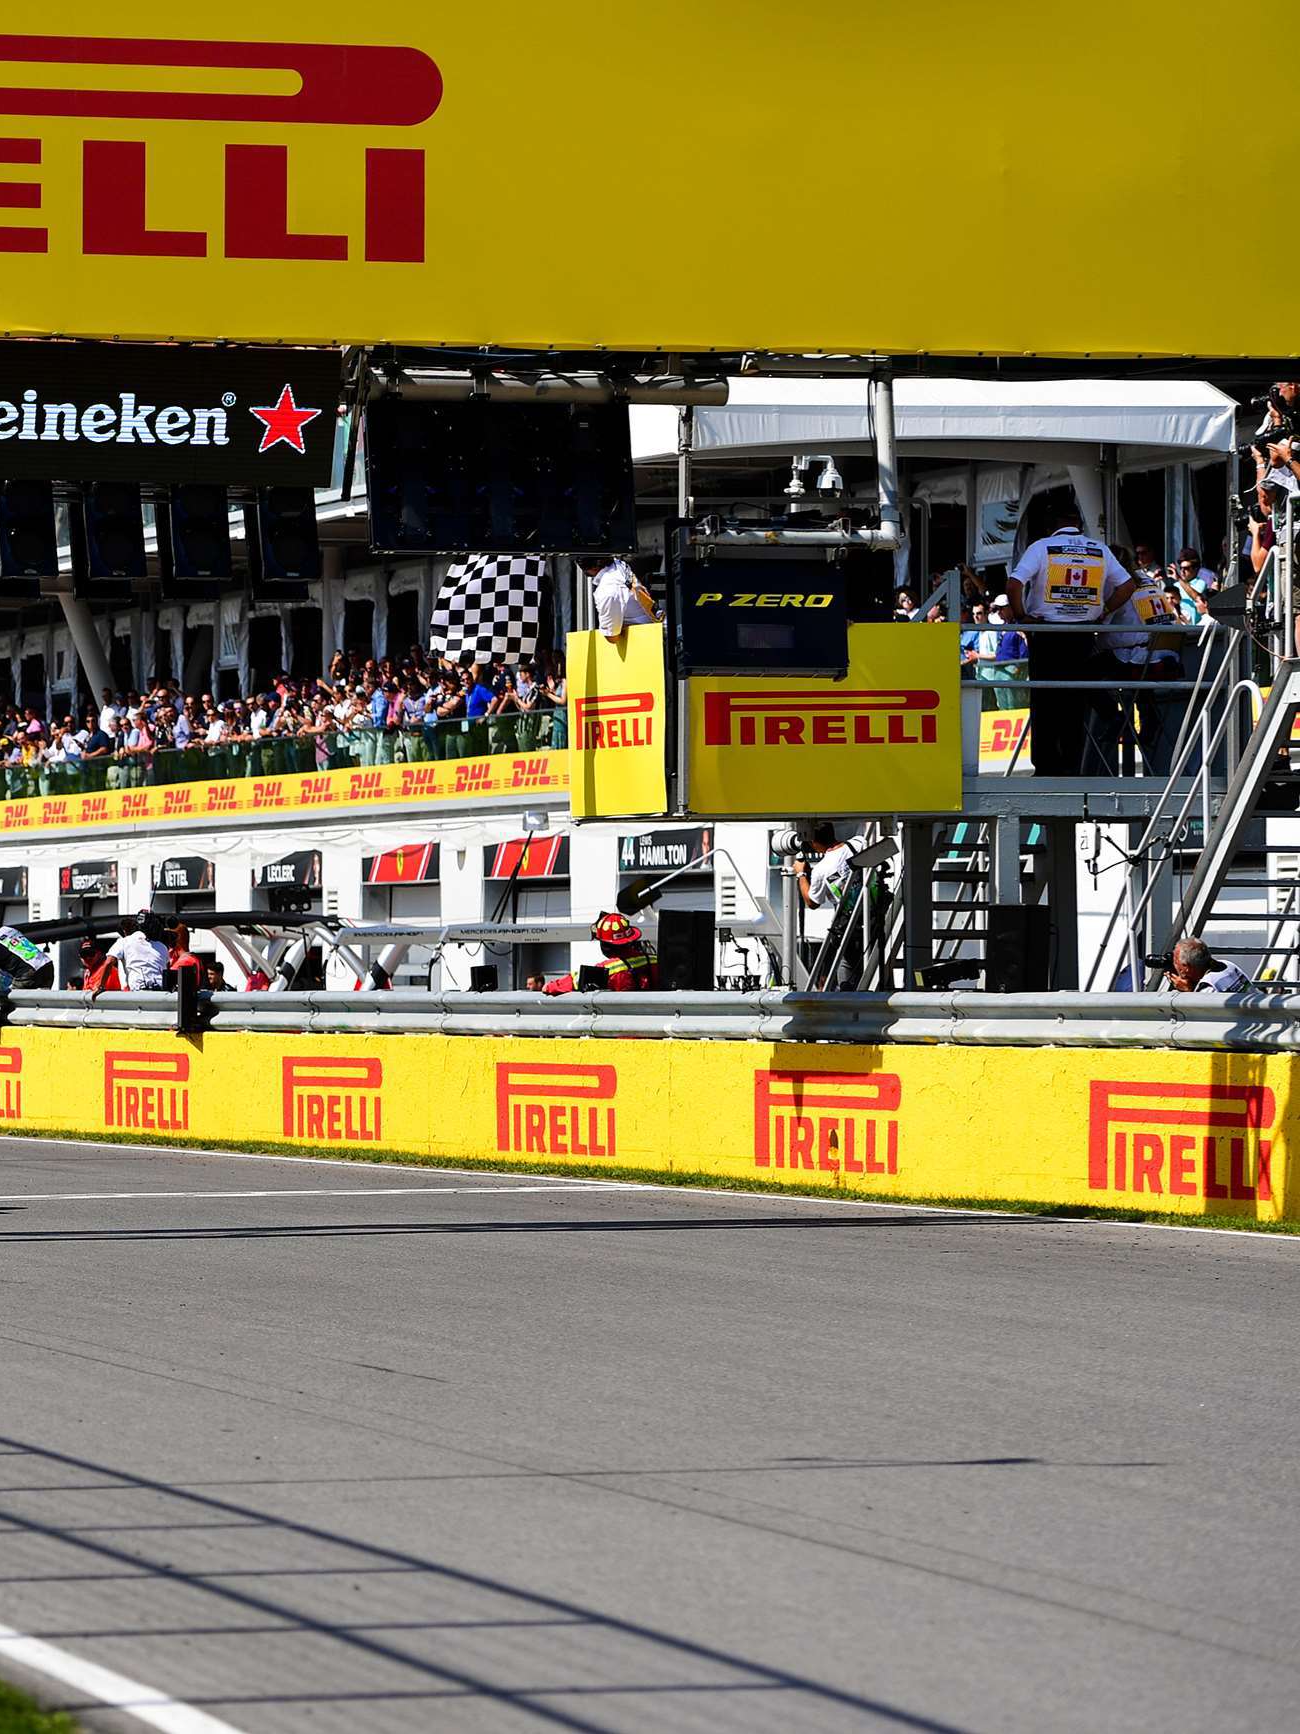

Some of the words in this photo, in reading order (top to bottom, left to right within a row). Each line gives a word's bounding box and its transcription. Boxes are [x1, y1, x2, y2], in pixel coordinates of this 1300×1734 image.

[695, 593, 723, 606] P
[728, 594, 834, 608] ZERO
[575, 692, 655, 751] PIRELLI
[705, 690, 940, 745] PIRELLI
[991, 719, 1030, 752] DH
[350, 772, 384, 800] DHL
[401, 768, 437, 796] DHL
[455, 763, 493, 792] DHL
[511, 758, 551, 788] DHL
[163, 790, 192, 814] DHL
[207, 786, 236, 811] DHL
[253, 782, 284, 807] DHL
[300, 777, 333, 804] DHL
[4, 805, 29, 828] DHL
[42, 802, 69, 824] DHL
[81, 798, 108, 822] DHL
[121, 794, 149, 817] DHL
[621, 837, 635, 866] 44
[639, 844, 688, 867] HAMILTON
[165, 869, 189, 887] VETTEL
[267, 864, 295, 883] LECLERC
[104, 1051, 190, 1131] PIRELLI
[282, 1056, 383, 1141] PIRELLI
[496, 1062, 617, 1157] PIRELLI
[754, 1068, 902, 1175] PIRELLI
[1088, 1079, 1276, 1201] PIRELLI
